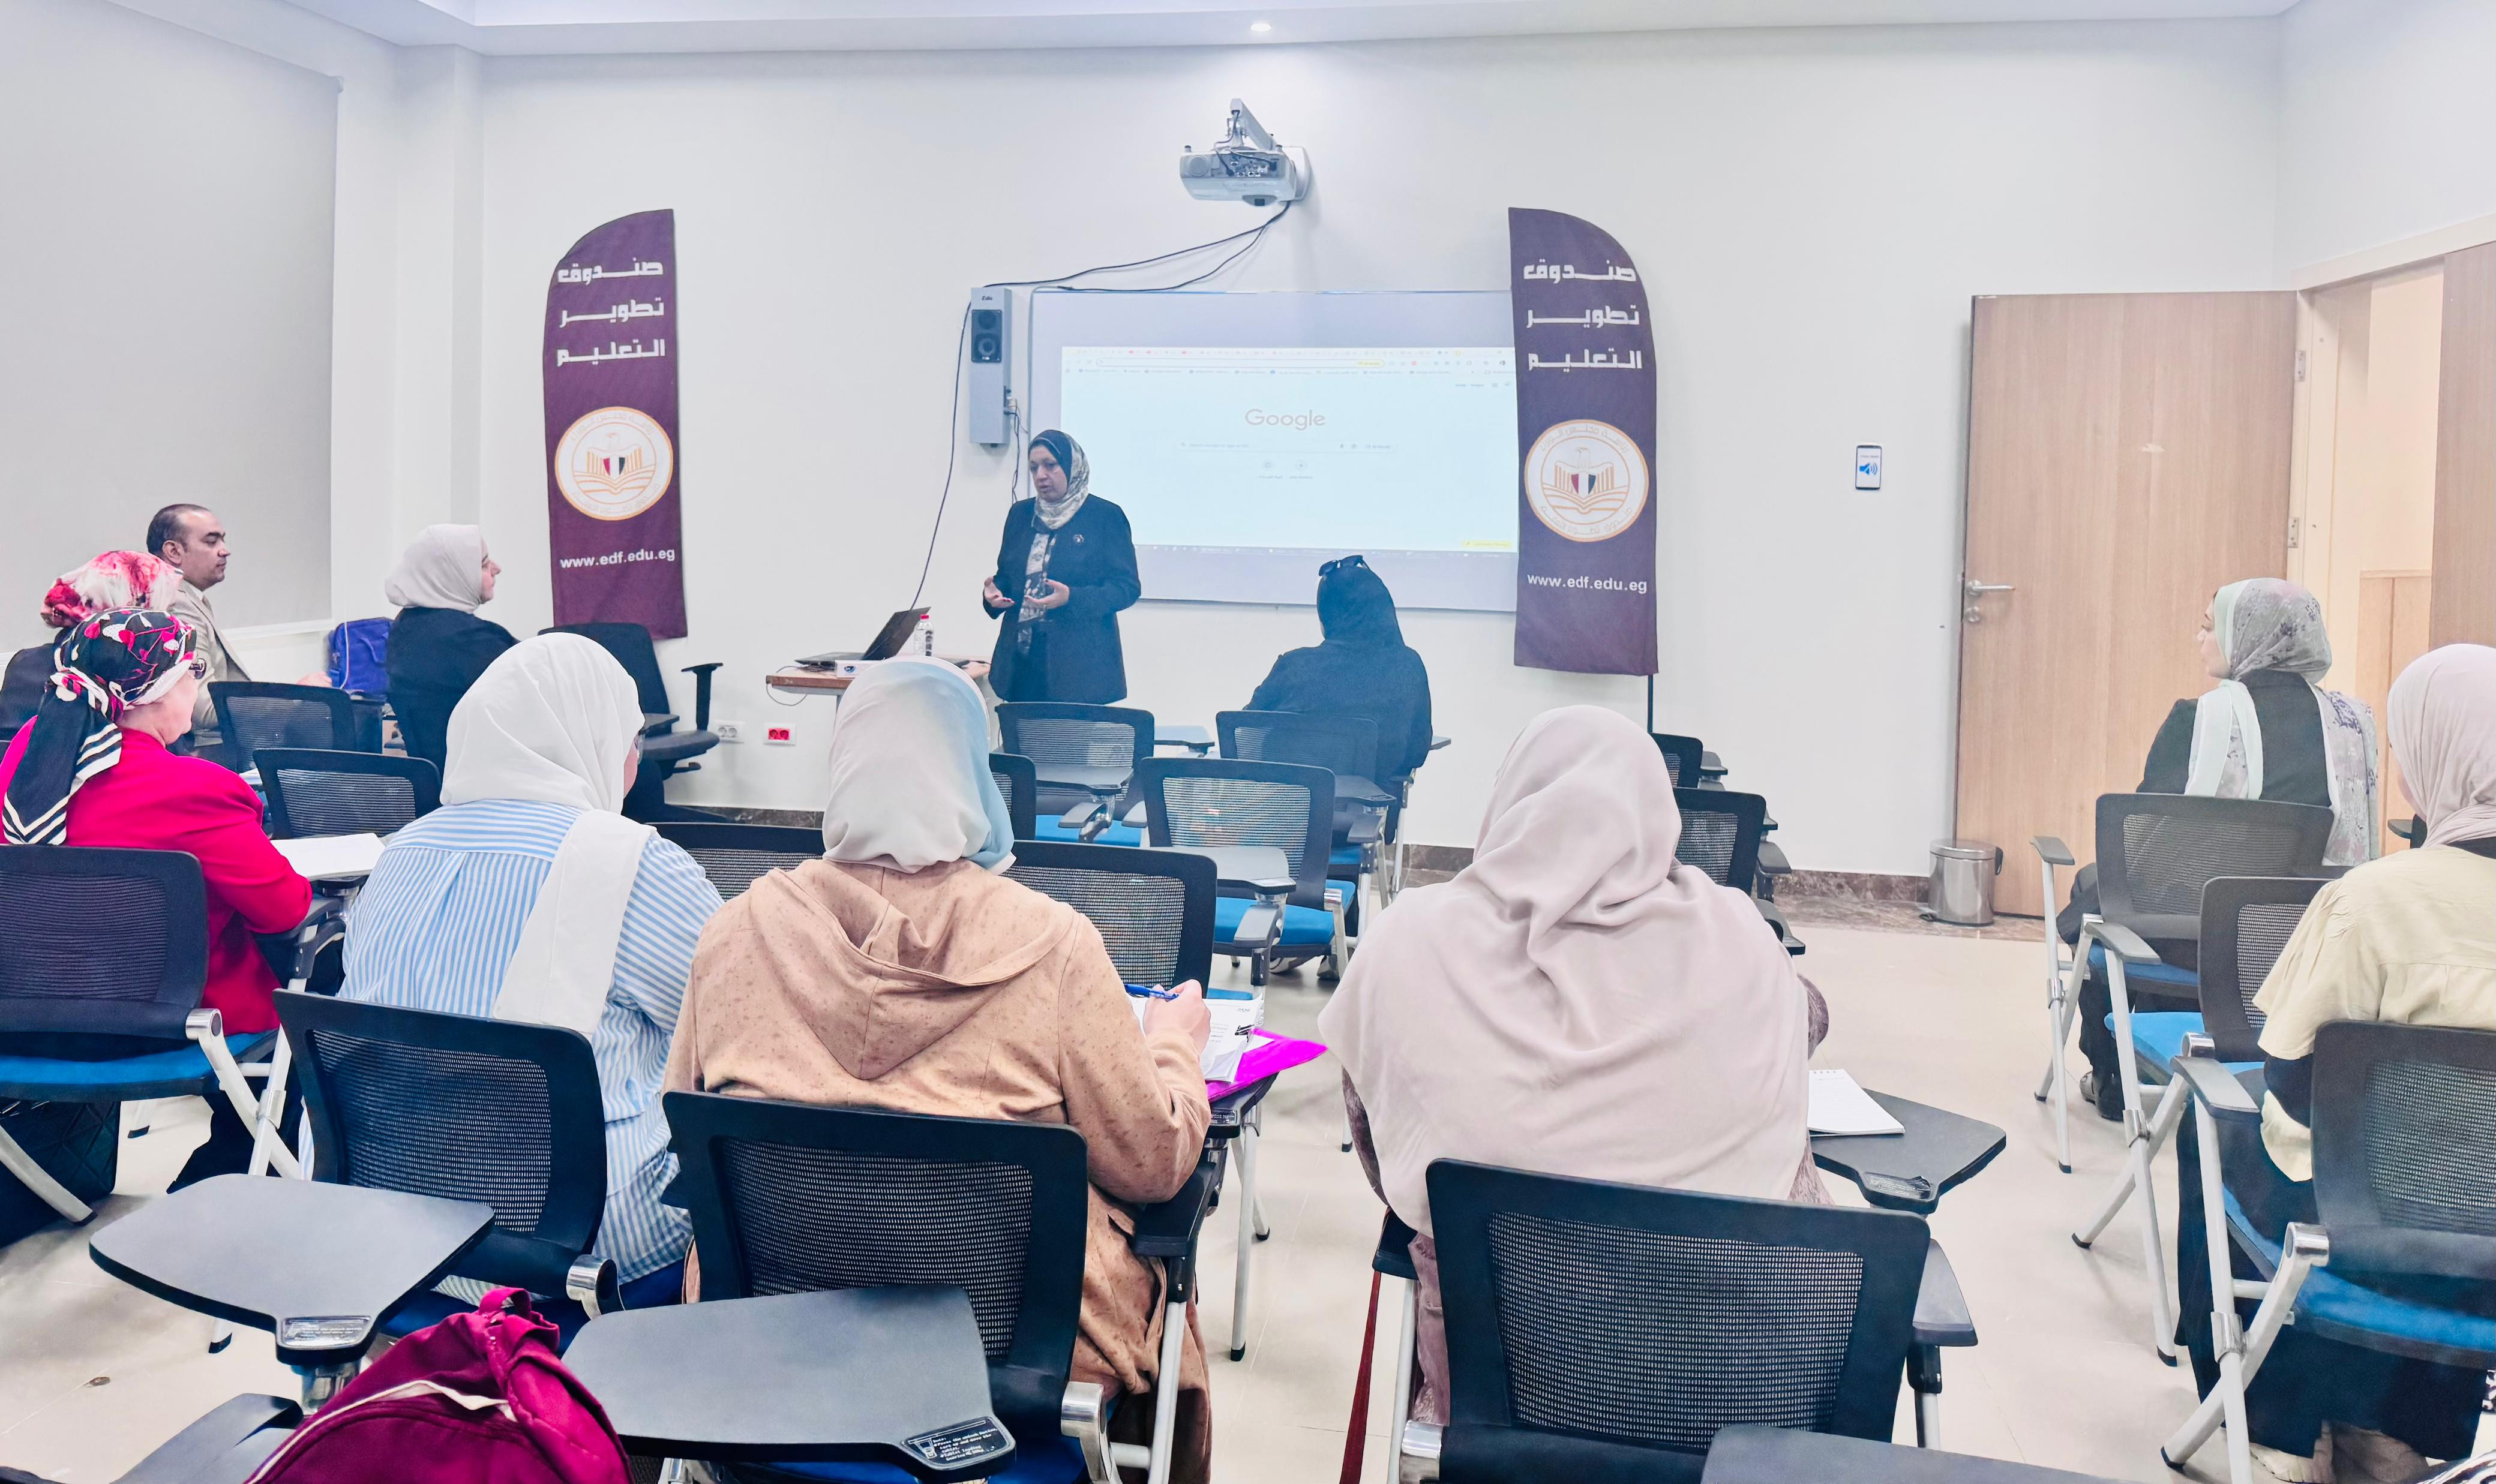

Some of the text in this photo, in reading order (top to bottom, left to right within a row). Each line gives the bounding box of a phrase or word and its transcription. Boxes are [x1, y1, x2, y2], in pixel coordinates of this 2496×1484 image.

[557, 257, 664, 285] صندوق
[1523, 259, 1637, 284] صندوق
[559, 297, 664, 328] تطوير
[1526, 305, 1639, 328] تطوير
[557, 339, 665, 367] التعليم
[1528, 348, 1642, 372] التعليم
[1245, 409, 1326, 430] Google
[560, 549, 675, 569] www.edf.edu.eg
[1527, 574, 1648, 594] www.edf.edu.eg
